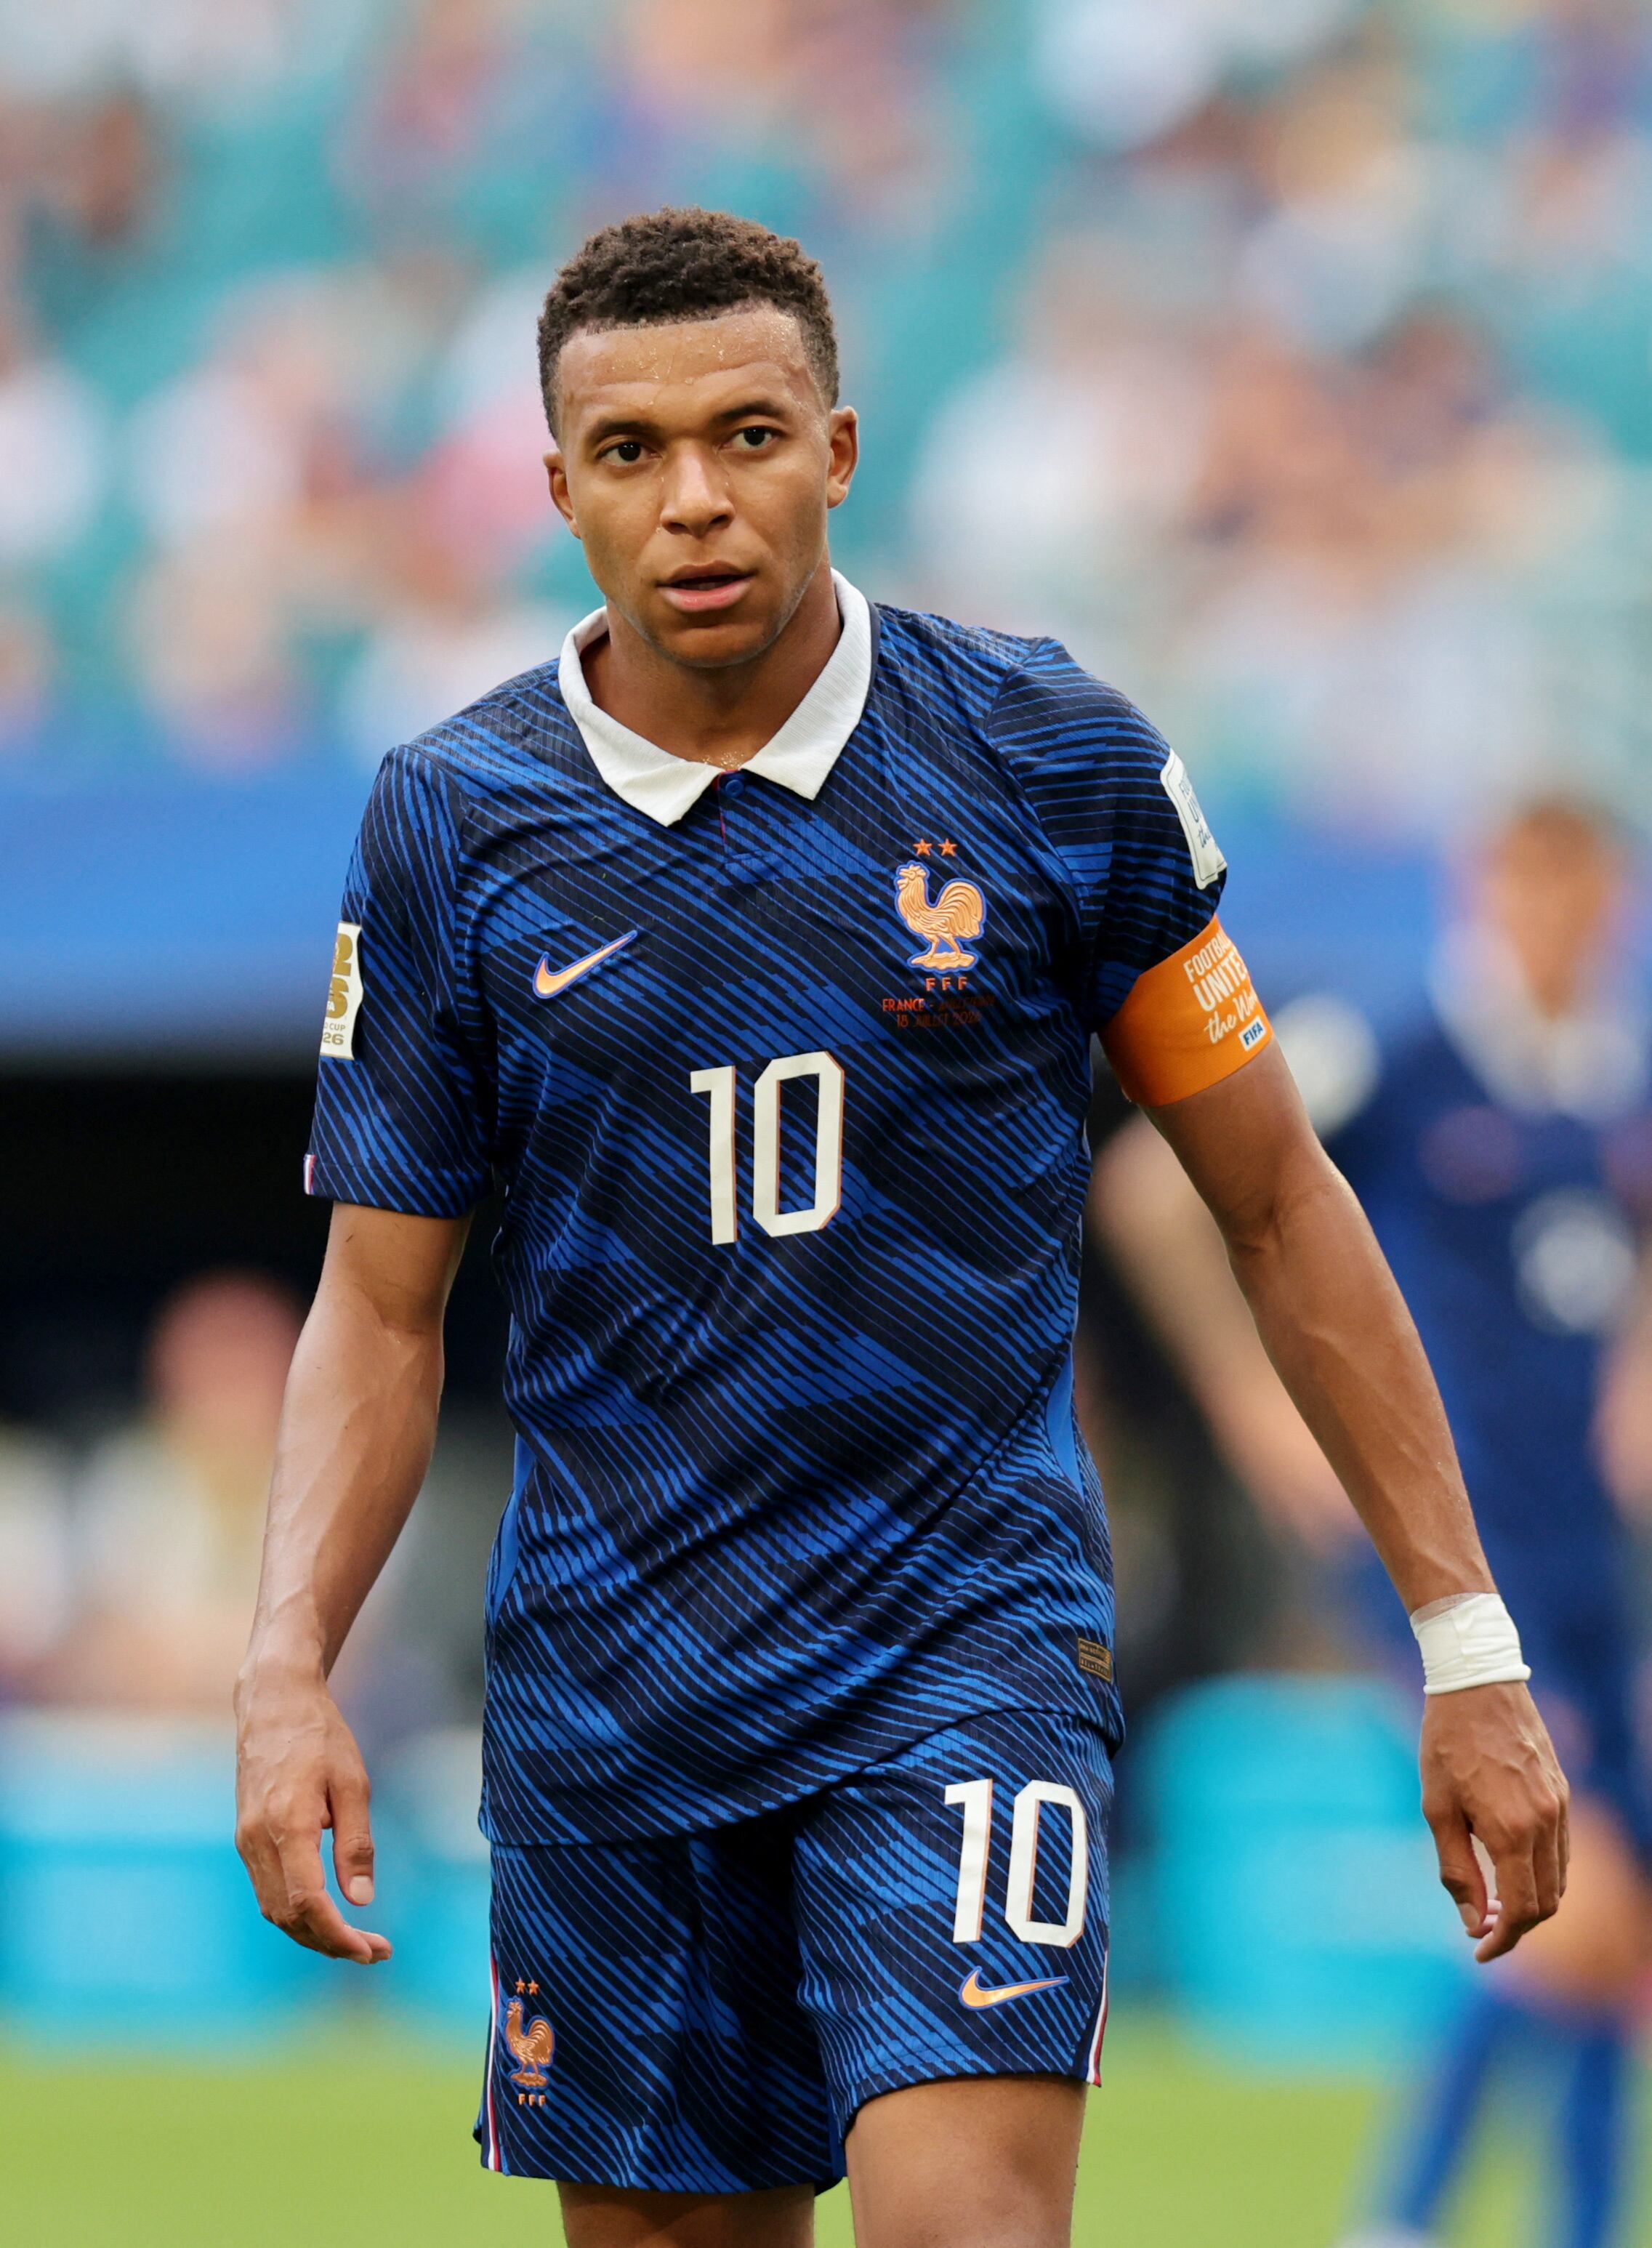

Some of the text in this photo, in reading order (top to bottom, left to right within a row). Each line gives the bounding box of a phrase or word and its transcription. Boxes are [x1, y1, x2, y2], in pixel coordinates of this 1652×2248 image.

[882, 999, 925, 1012] FRANCE
[329, 1023, 346, 1031] CUP
[896, 1014, 908, 1028] 18
[1204, 1010, 1237, 1044] the
[323, 1032, 344, 1046] 26
[1242, 1019, 1264, 1046] FIFA
[690, 1050, 845, 1246] 10
[944, 1778, 1089, 1949] 10
